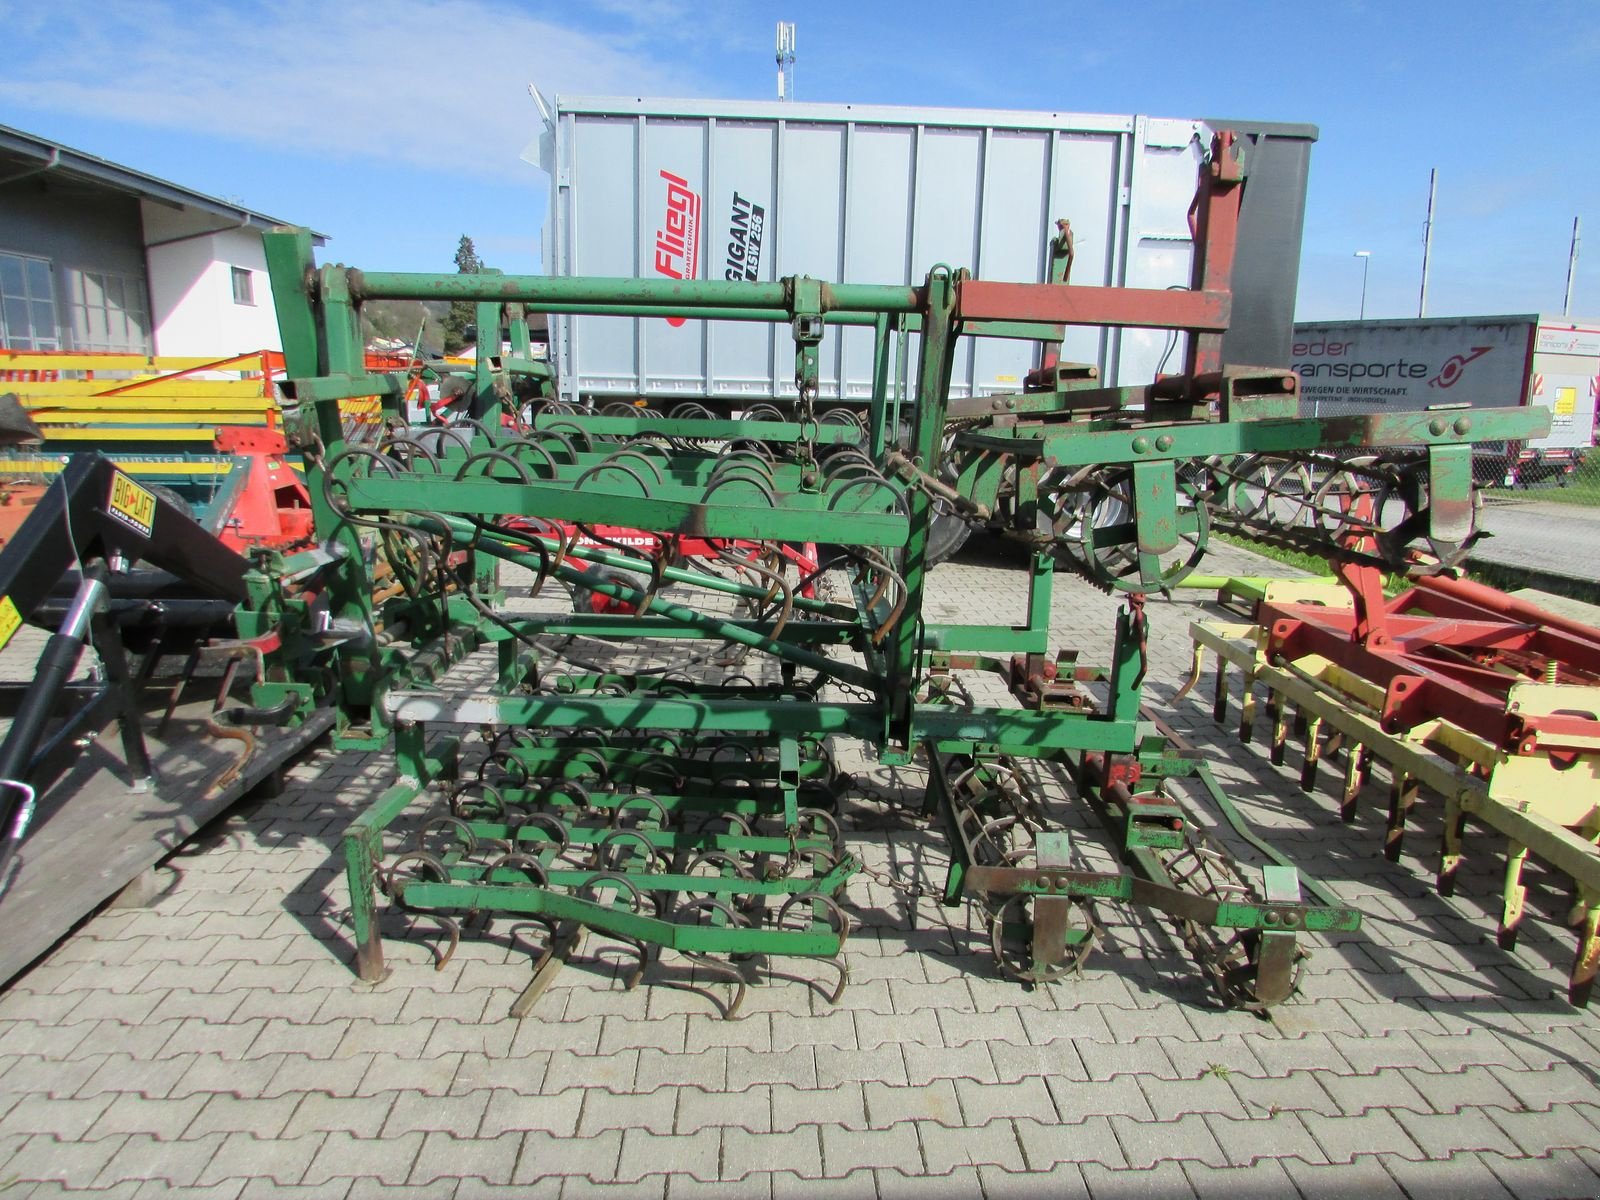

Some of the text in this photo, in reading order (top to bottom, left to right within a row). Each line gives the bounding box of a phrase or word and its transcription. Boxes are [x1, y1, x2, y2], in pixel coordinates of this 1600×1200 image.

[655, 169, 696, 280] Fliegl
[684, 218, 694, 280] GRARTECHNIK
[725, 191, 751, 282] GIGANT
[746, 214, 763, 276] ASW 256
[1291, 359, 1428, 382] ransporte
[1292, 338, 1354, 357] eder
[1300, 385, 1334, 395] EWEGEN
[1336, 386, 1352, 395] DIE
[114, 477, 154, 523] BIG LIFT
